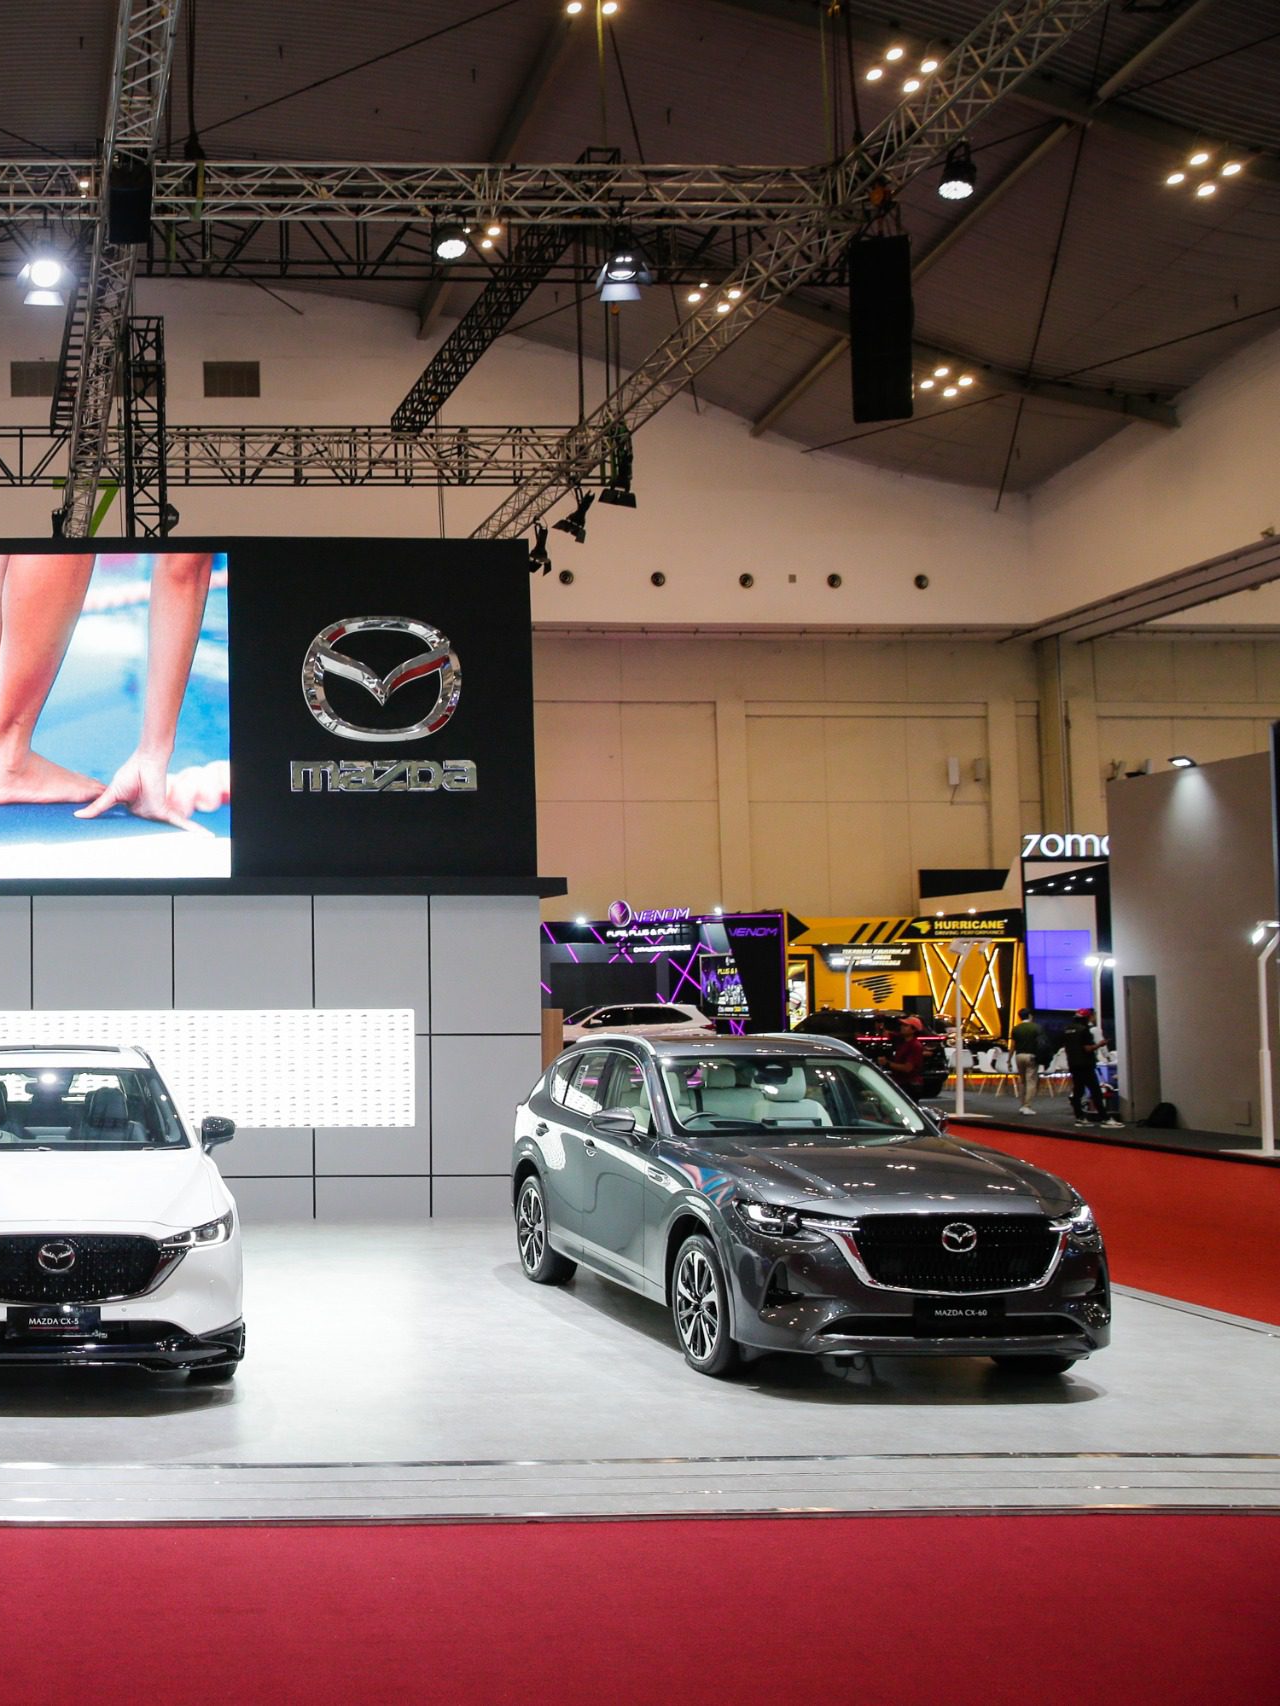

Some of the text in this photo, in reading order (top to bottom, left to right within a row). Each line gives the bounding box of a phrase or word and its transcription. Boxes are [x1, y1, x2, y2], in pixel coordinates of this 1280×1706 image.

[290, 760, 478, 792] mazda
[633, 907, 690, 922] VENOM
[934, 920, 1005, 929] HURRICANE
[728, 927, 778, 937] VENOM
